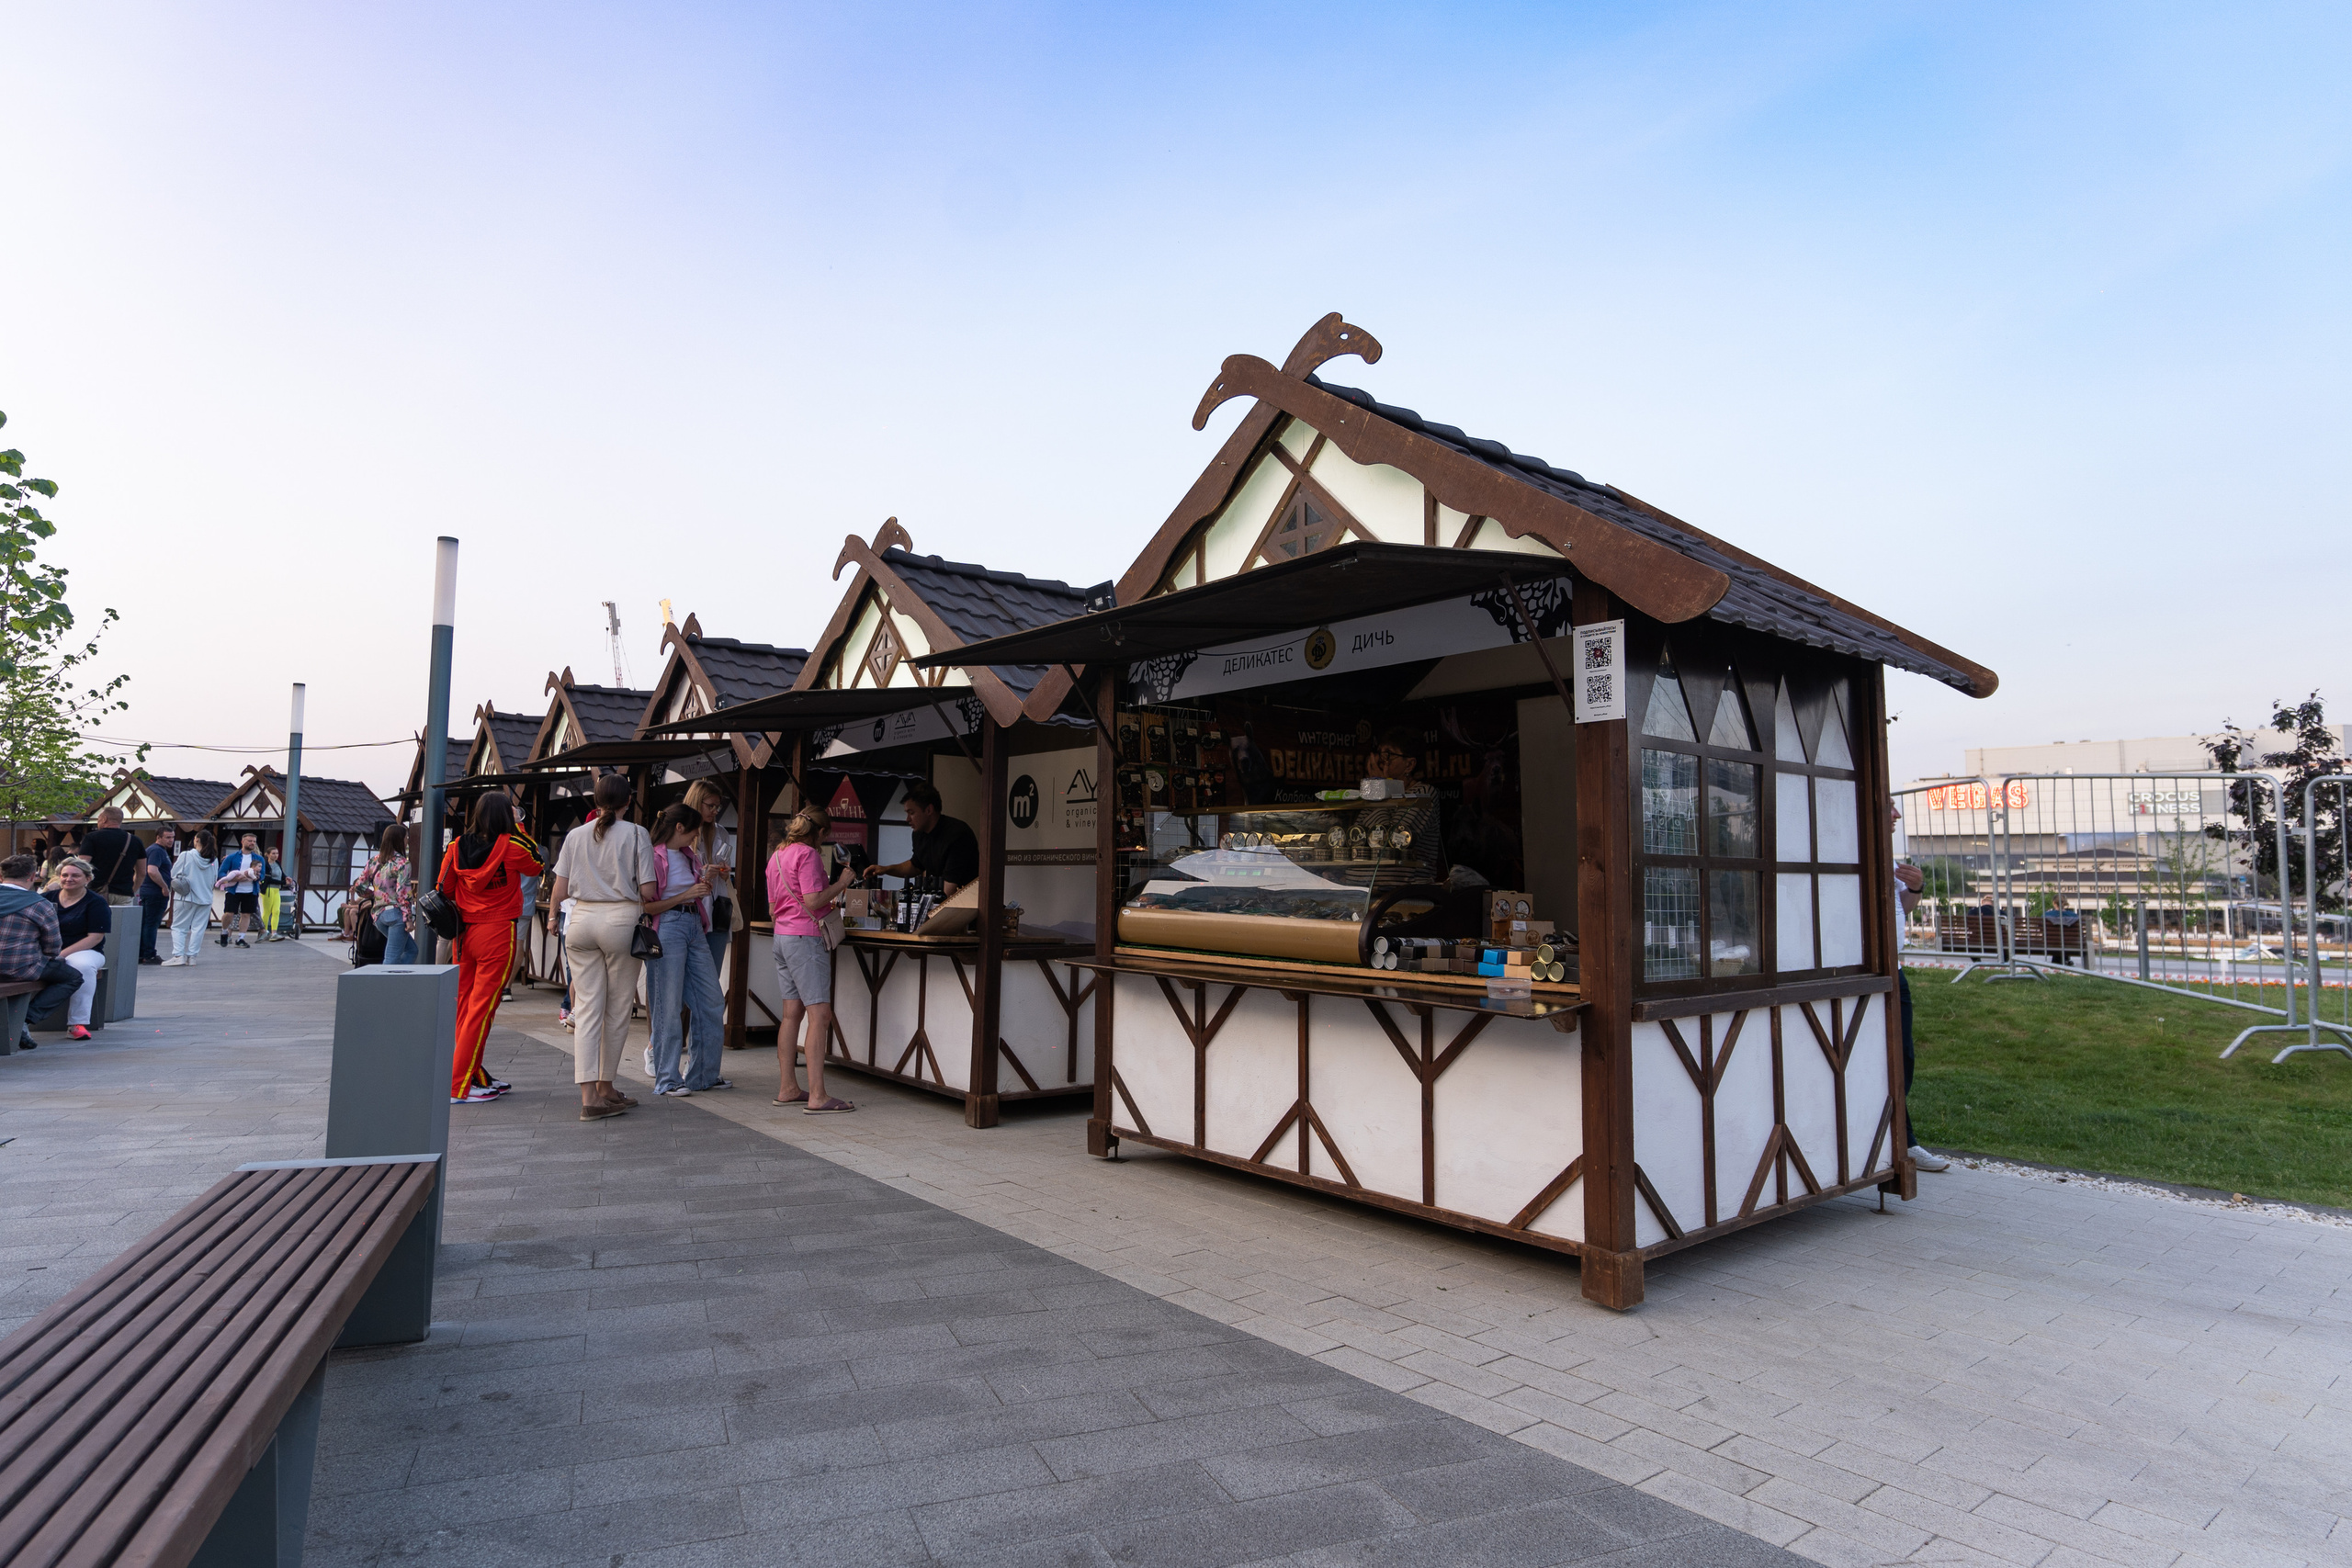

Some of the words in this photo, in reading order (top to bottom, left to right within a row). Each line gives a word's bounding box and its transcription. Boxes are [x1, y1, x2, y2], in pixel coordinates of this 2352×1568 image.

[1223, 648, 1293, 676] ДЕЛИКАТЕС
[1352, 630, 1395, 653] ДИЧЬ
[1297, 731, 1356, 750] интернет
[1928, 784, 2030, 810] VEGAS
[2130, 791, 2199, 803] CROCUS
[1067, 807, 1097, 818] organic
[1033, 853, 1080, 862] ОРГАНИЧЕСКОГО
